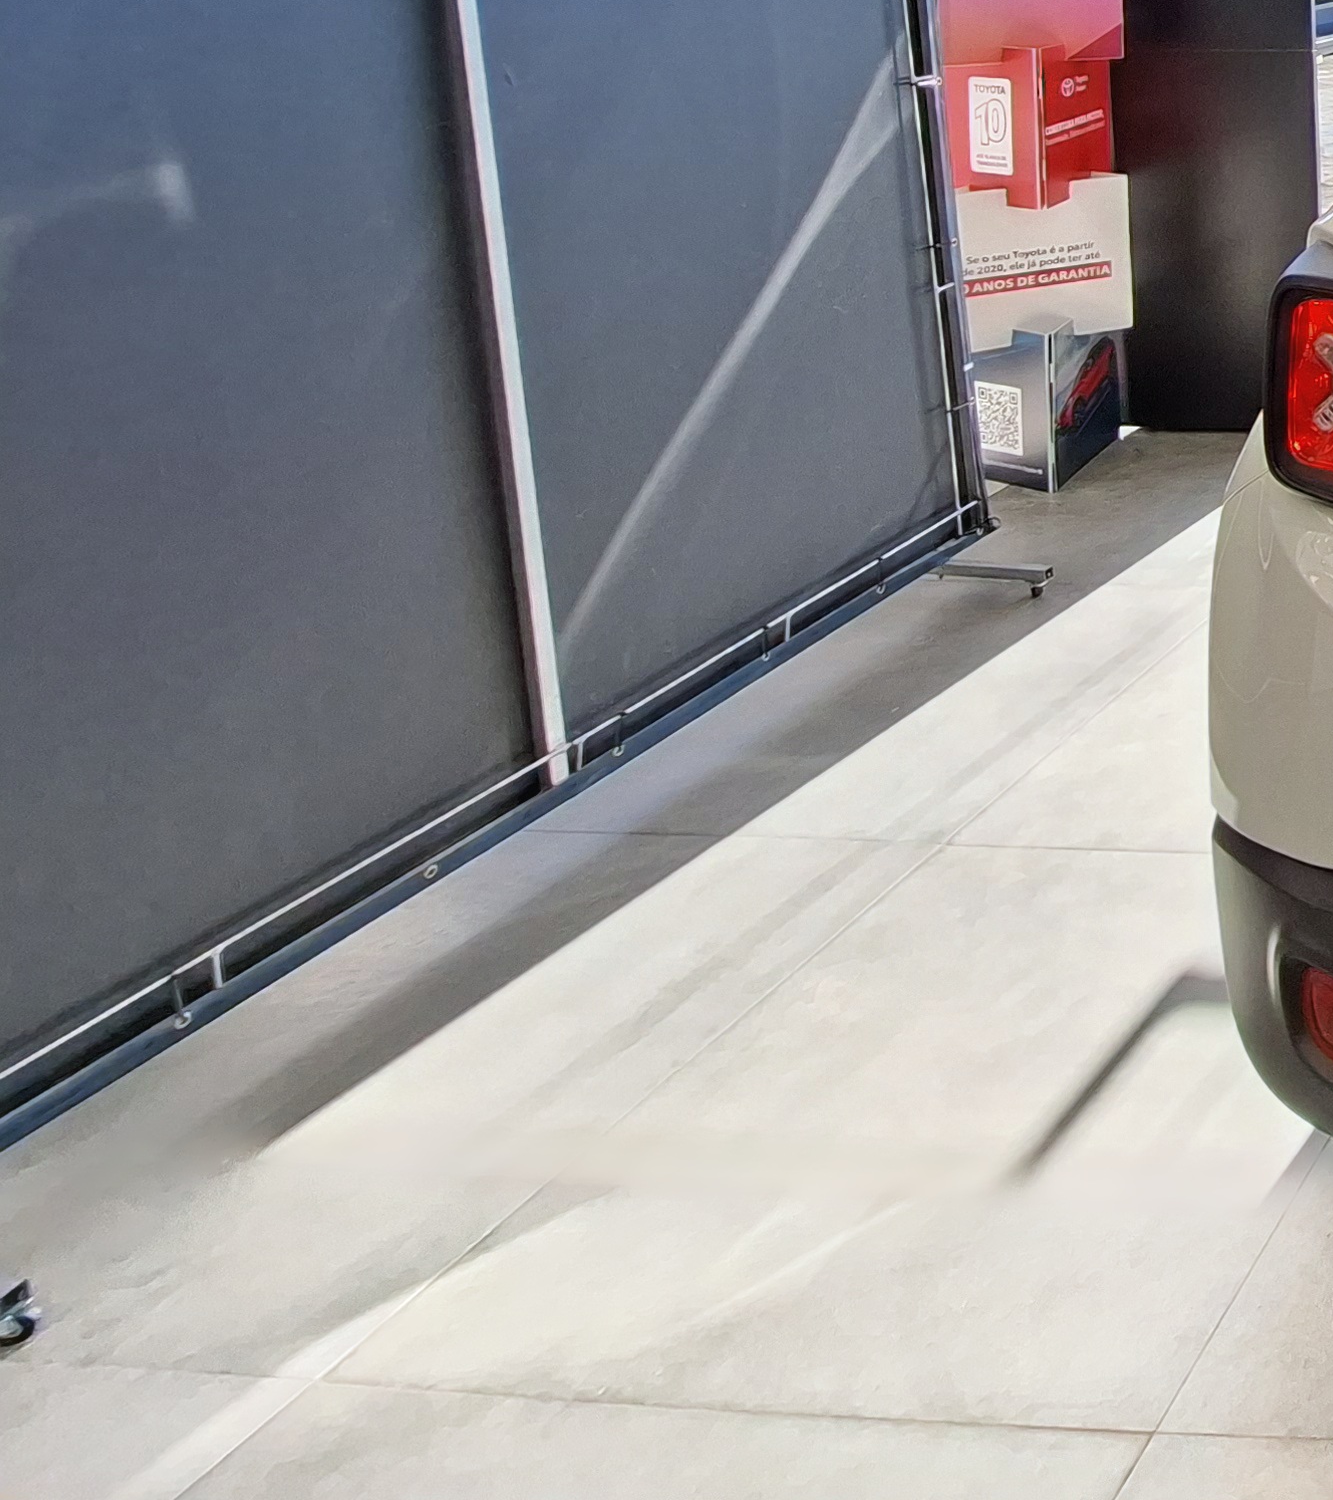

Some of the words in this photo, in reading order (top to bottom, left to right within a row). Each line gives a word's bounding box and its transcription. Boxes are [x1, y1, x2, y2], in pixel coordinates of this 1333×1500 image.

[974, 84, 1006, 95] TOYOTA
[975, 98, 1007, 146] 10
[966, 256, 979, 264] Se
[992, 253, 1010, 261] seu
[1012, 248, 1047, 259] Toyota
[1050, 245, 1056, 254] é
[1067, 241, 1095, 253] partir
[977, 264, 1007, 274] 2020,
[1010, 262, 1025, 270] ele
[1039, 256, 1066, 267] pode
[1068, 254, 1082, 262] ter
[1085, 250, 1100, 260] até
[972, 278, 1015, 293] ANOS
[1017, 275, 1036, 287] DE
[1038, 264, 1110, 283] GARANTIA
